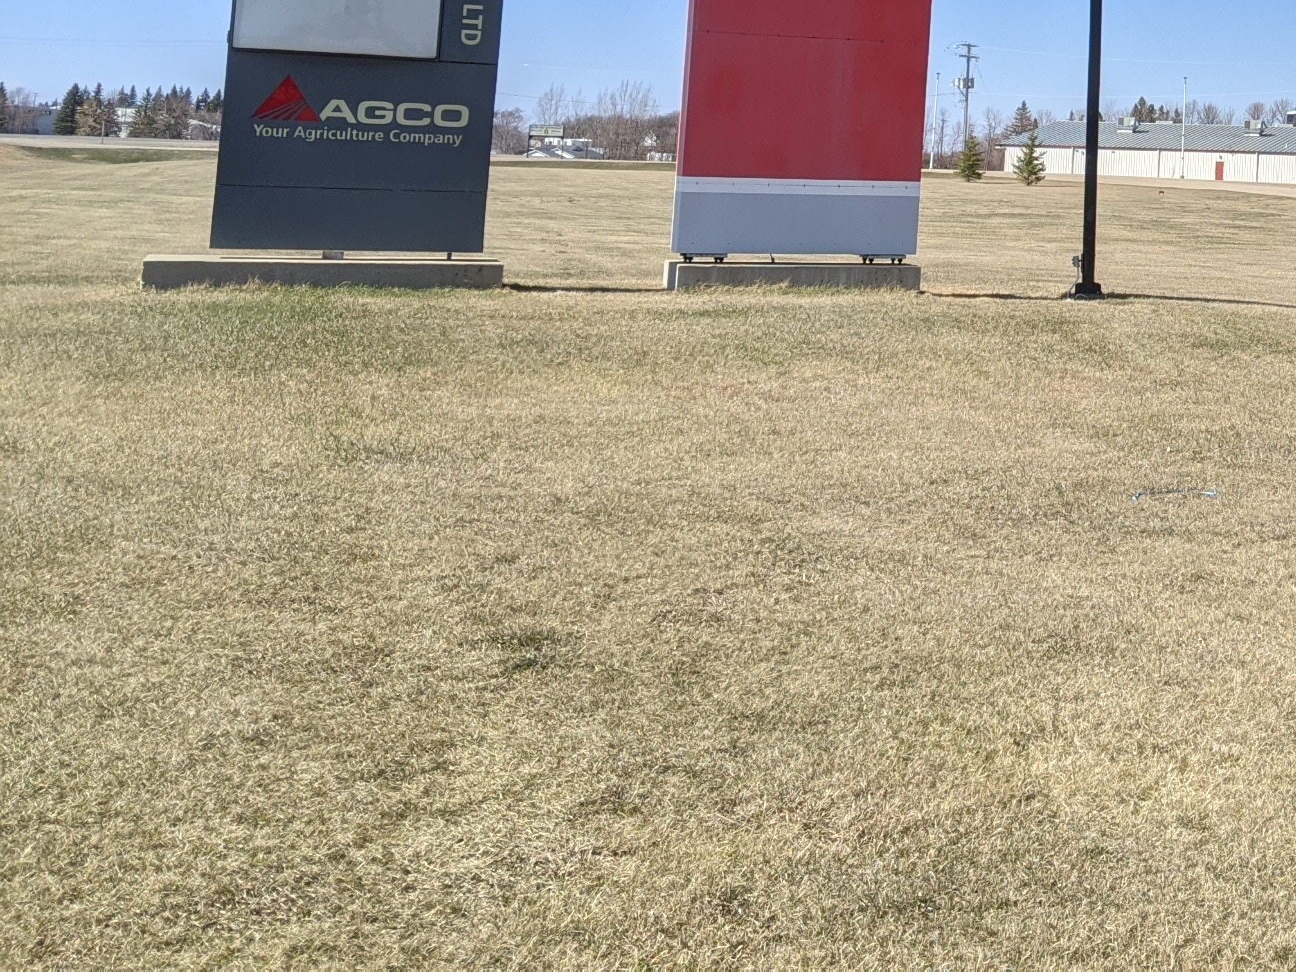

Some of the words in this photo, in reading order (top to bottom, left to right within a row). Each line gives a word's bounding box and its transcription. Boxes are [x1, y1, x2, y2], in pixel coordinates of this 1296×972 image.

[460, 4, 482, 46] LTD
[319, 99, 469, 128] AGCO
[253, 123, 289, 138] Your
[293, 125, 384, 143] Agriculture
[389, 130, 463, 147] Company
